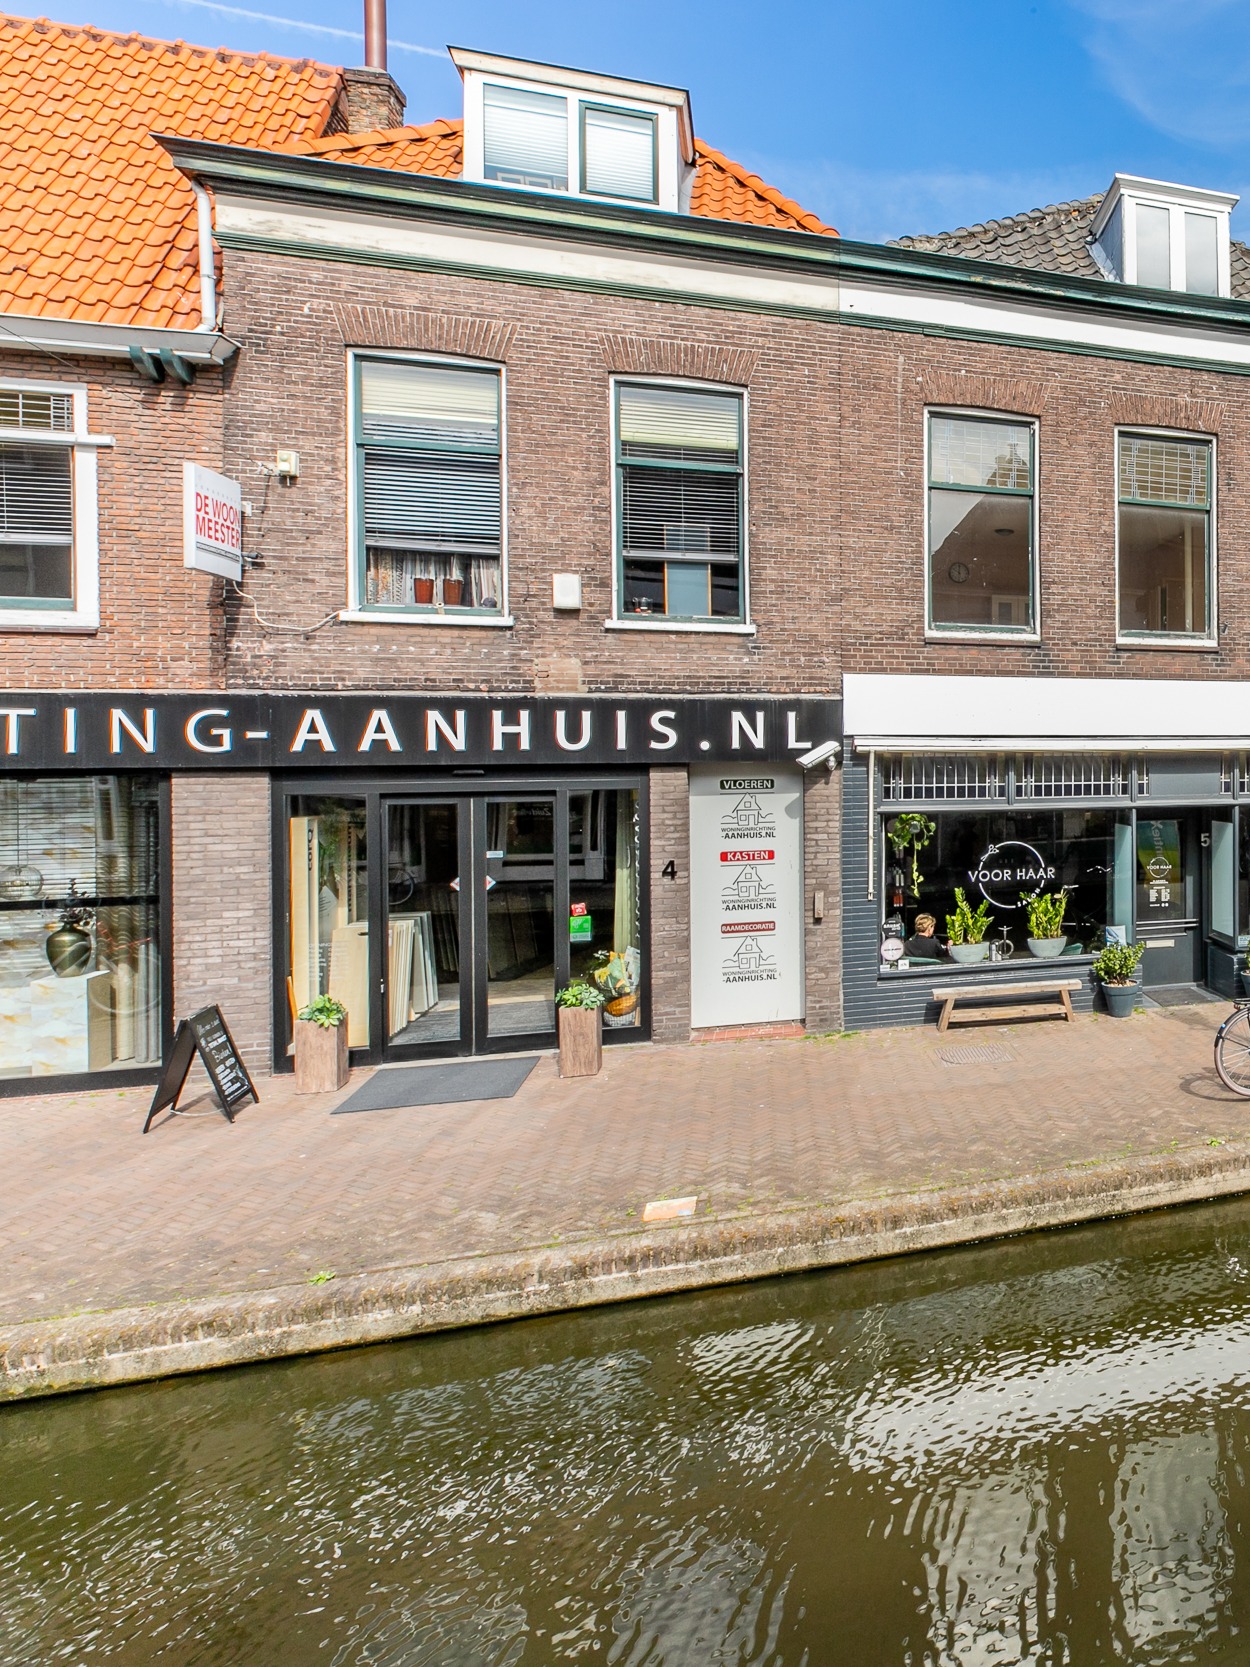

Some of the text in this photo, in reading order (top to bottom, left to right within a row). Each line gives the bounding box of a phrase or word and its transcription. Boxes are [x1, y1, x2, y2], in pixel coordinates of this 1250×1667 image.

[195, 492, 240, 528] DE WOON
[195, 514, 240, 549] MEESTER
[723, 780, 771, 789] VLOEREN
[1201, 833, 1210, 847] 5
[727, 851, 769, 861] KASTEN
[662, 860, 677, 881] 4
[968, 867, 1055, 882] VOOR HAAR
[1017, 888, 1041, 907] SALON
[721, 903, 776, 911] -AANHUIS.NL
[721, 923, 775, 932] RAAMDECORATIE
[722, 968, 777, 976] WONINGINRICHTING
[722, 974, 777, 983] -AANHUIS.NL
